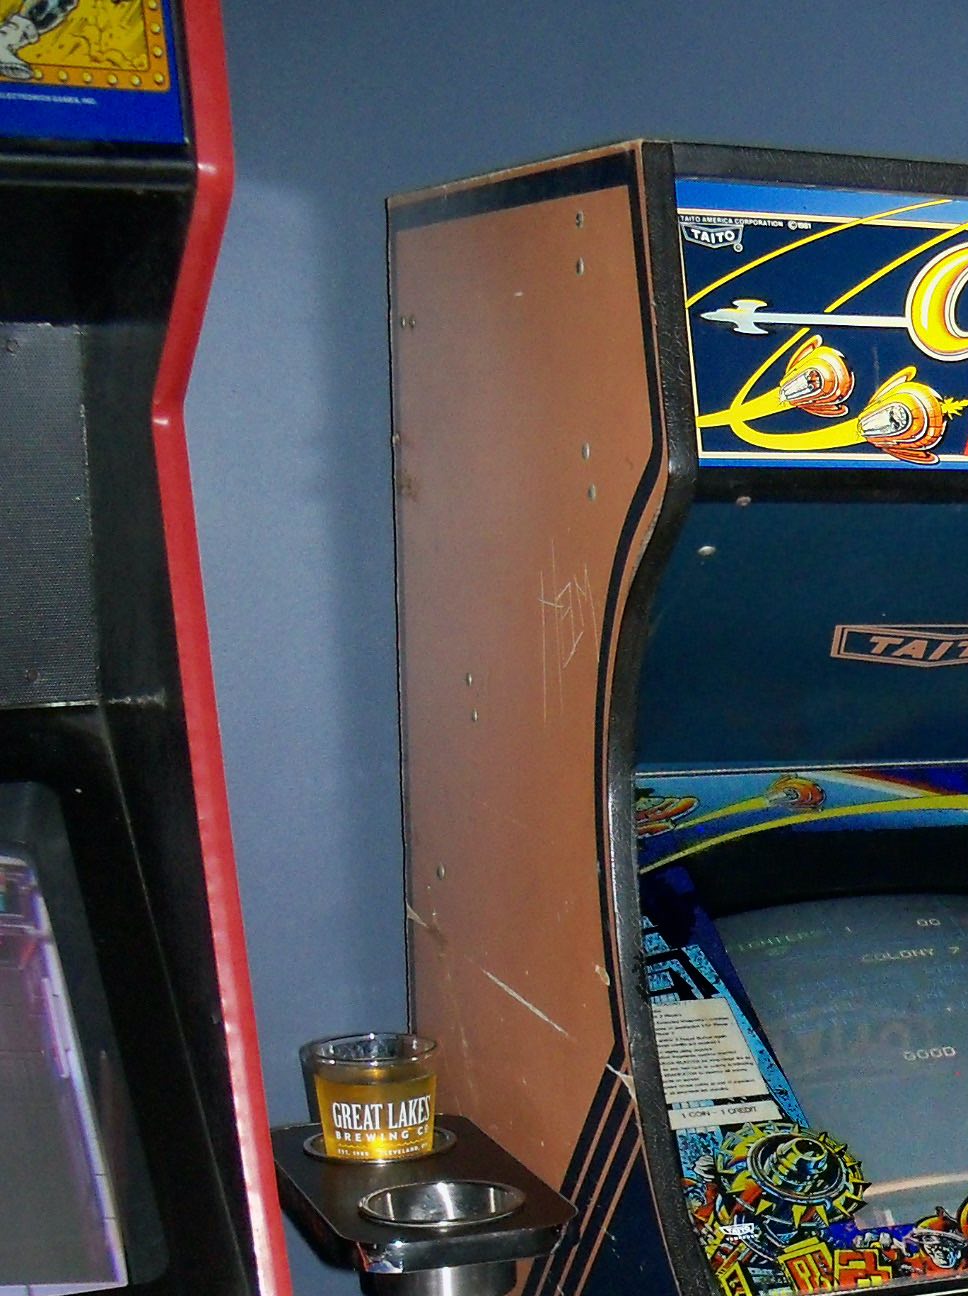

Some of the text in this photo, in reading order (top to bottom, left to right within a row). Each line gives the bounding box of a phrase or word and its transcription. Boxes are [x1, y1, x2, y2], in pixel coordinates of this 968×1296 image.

[680, 215, 701, 223] TAITO
[702, 216, 733, 225] AMERICA
[734, 218, 784, 228] CORPORATION
[690, 228, 735, 244] TAITO
[861, 948, 934, 963] COLONY
[903, 1046, 957, 1062] GOOD
[332, 1094, 431, 1130] GREAT LAKES
[688, 1110, 711, 1118] COIN
[728, 1106, 757, 1115] CREDIT
[335, 1130, 409, 1142] BREWING
